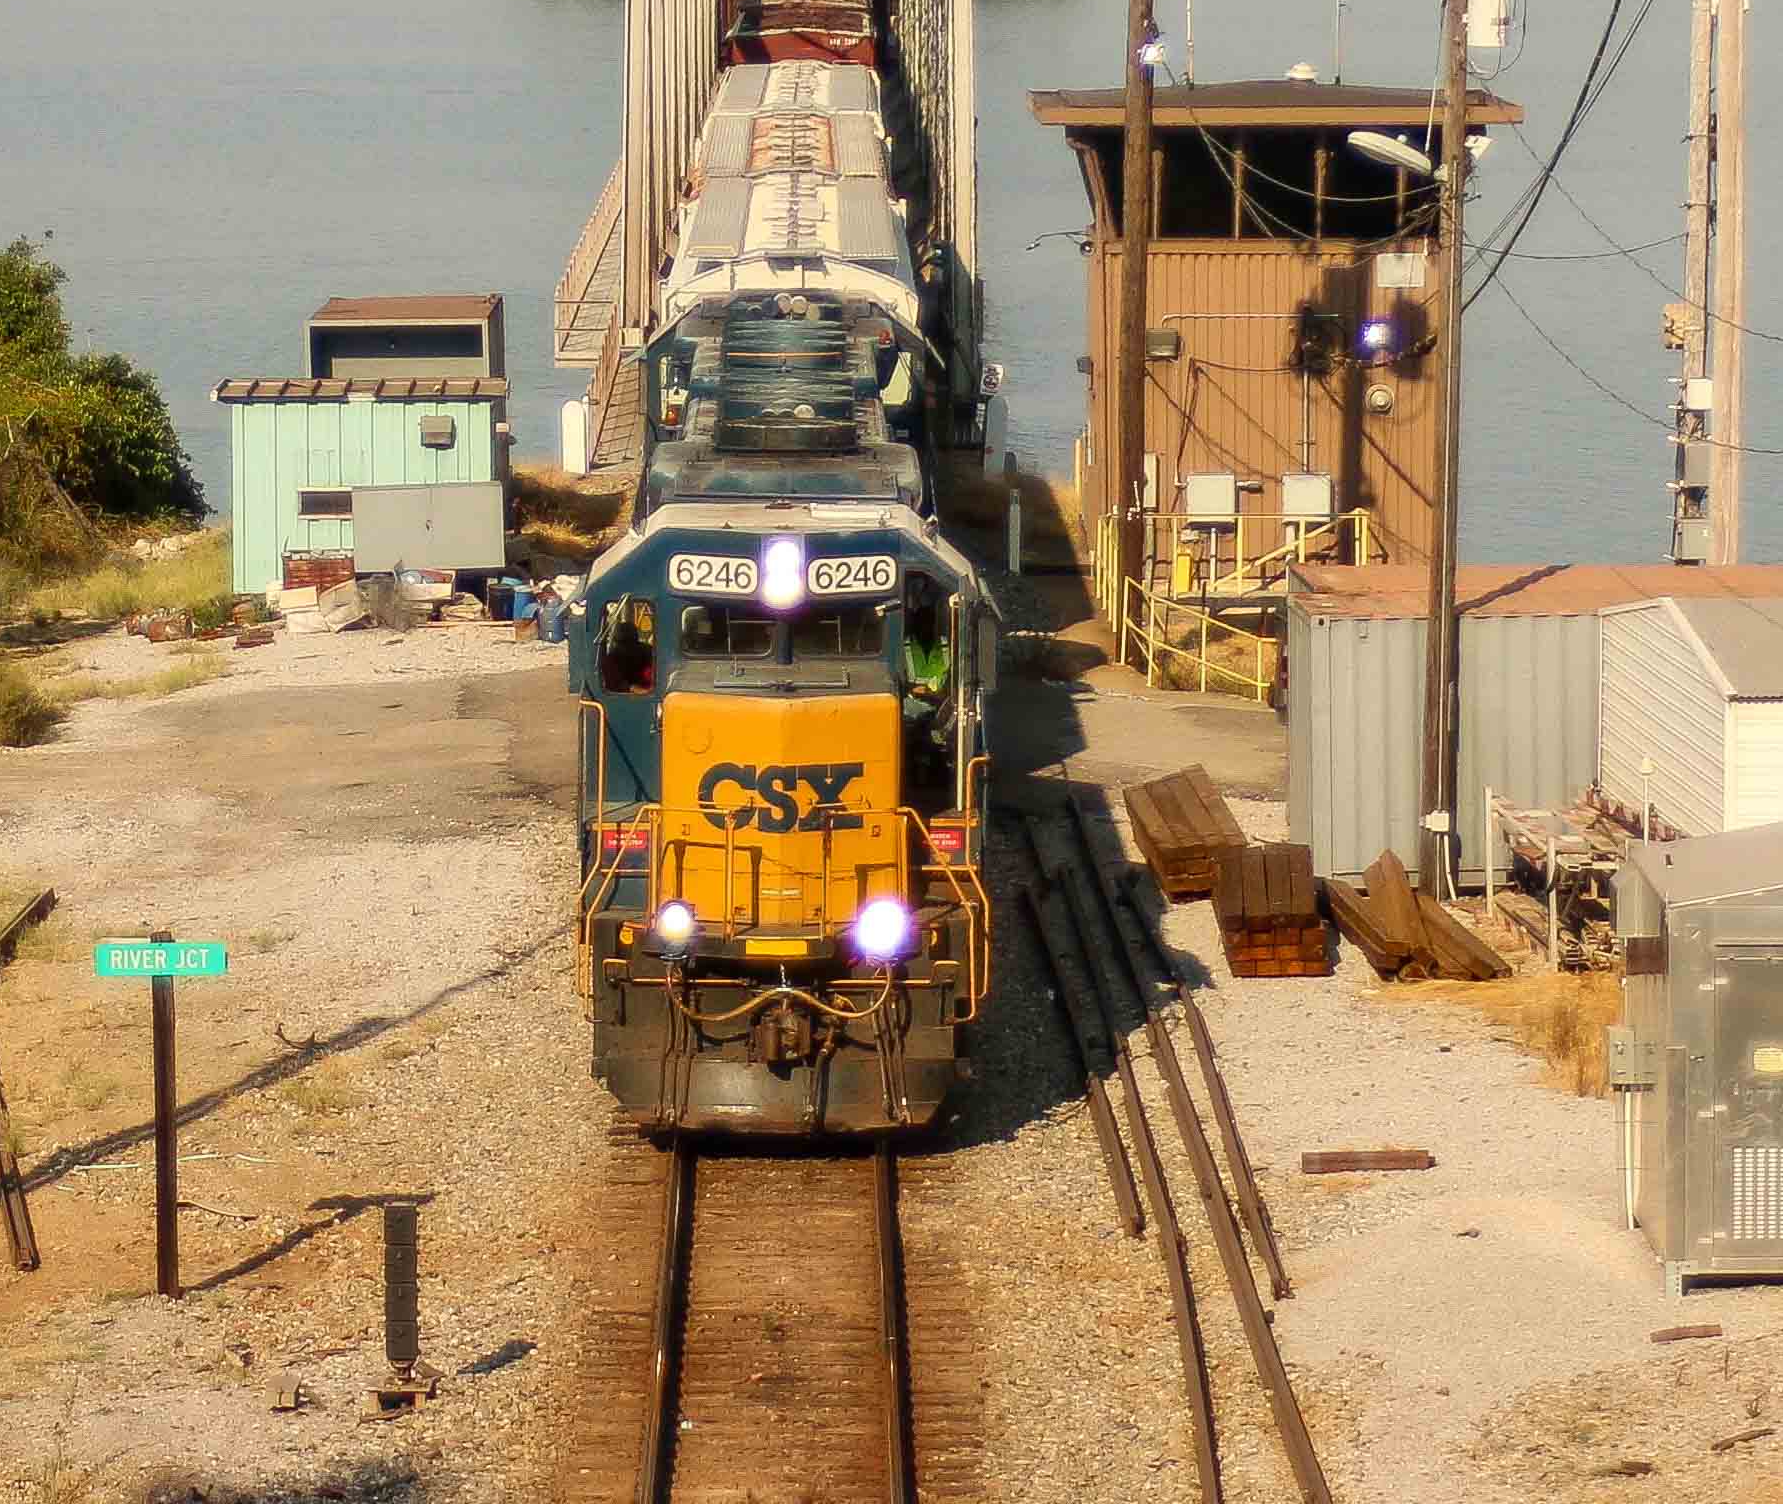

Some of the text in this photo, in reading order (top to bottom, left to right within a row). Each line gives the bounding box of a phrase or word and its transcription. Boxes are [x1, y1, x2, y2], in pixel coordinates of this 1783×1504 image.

[676, 558, 752, 590] 6246
[816, 559, 891, 590] 6246
[698, 762, 864, 833] CSX
[110, 948, 210, 969] RIVER JCT
